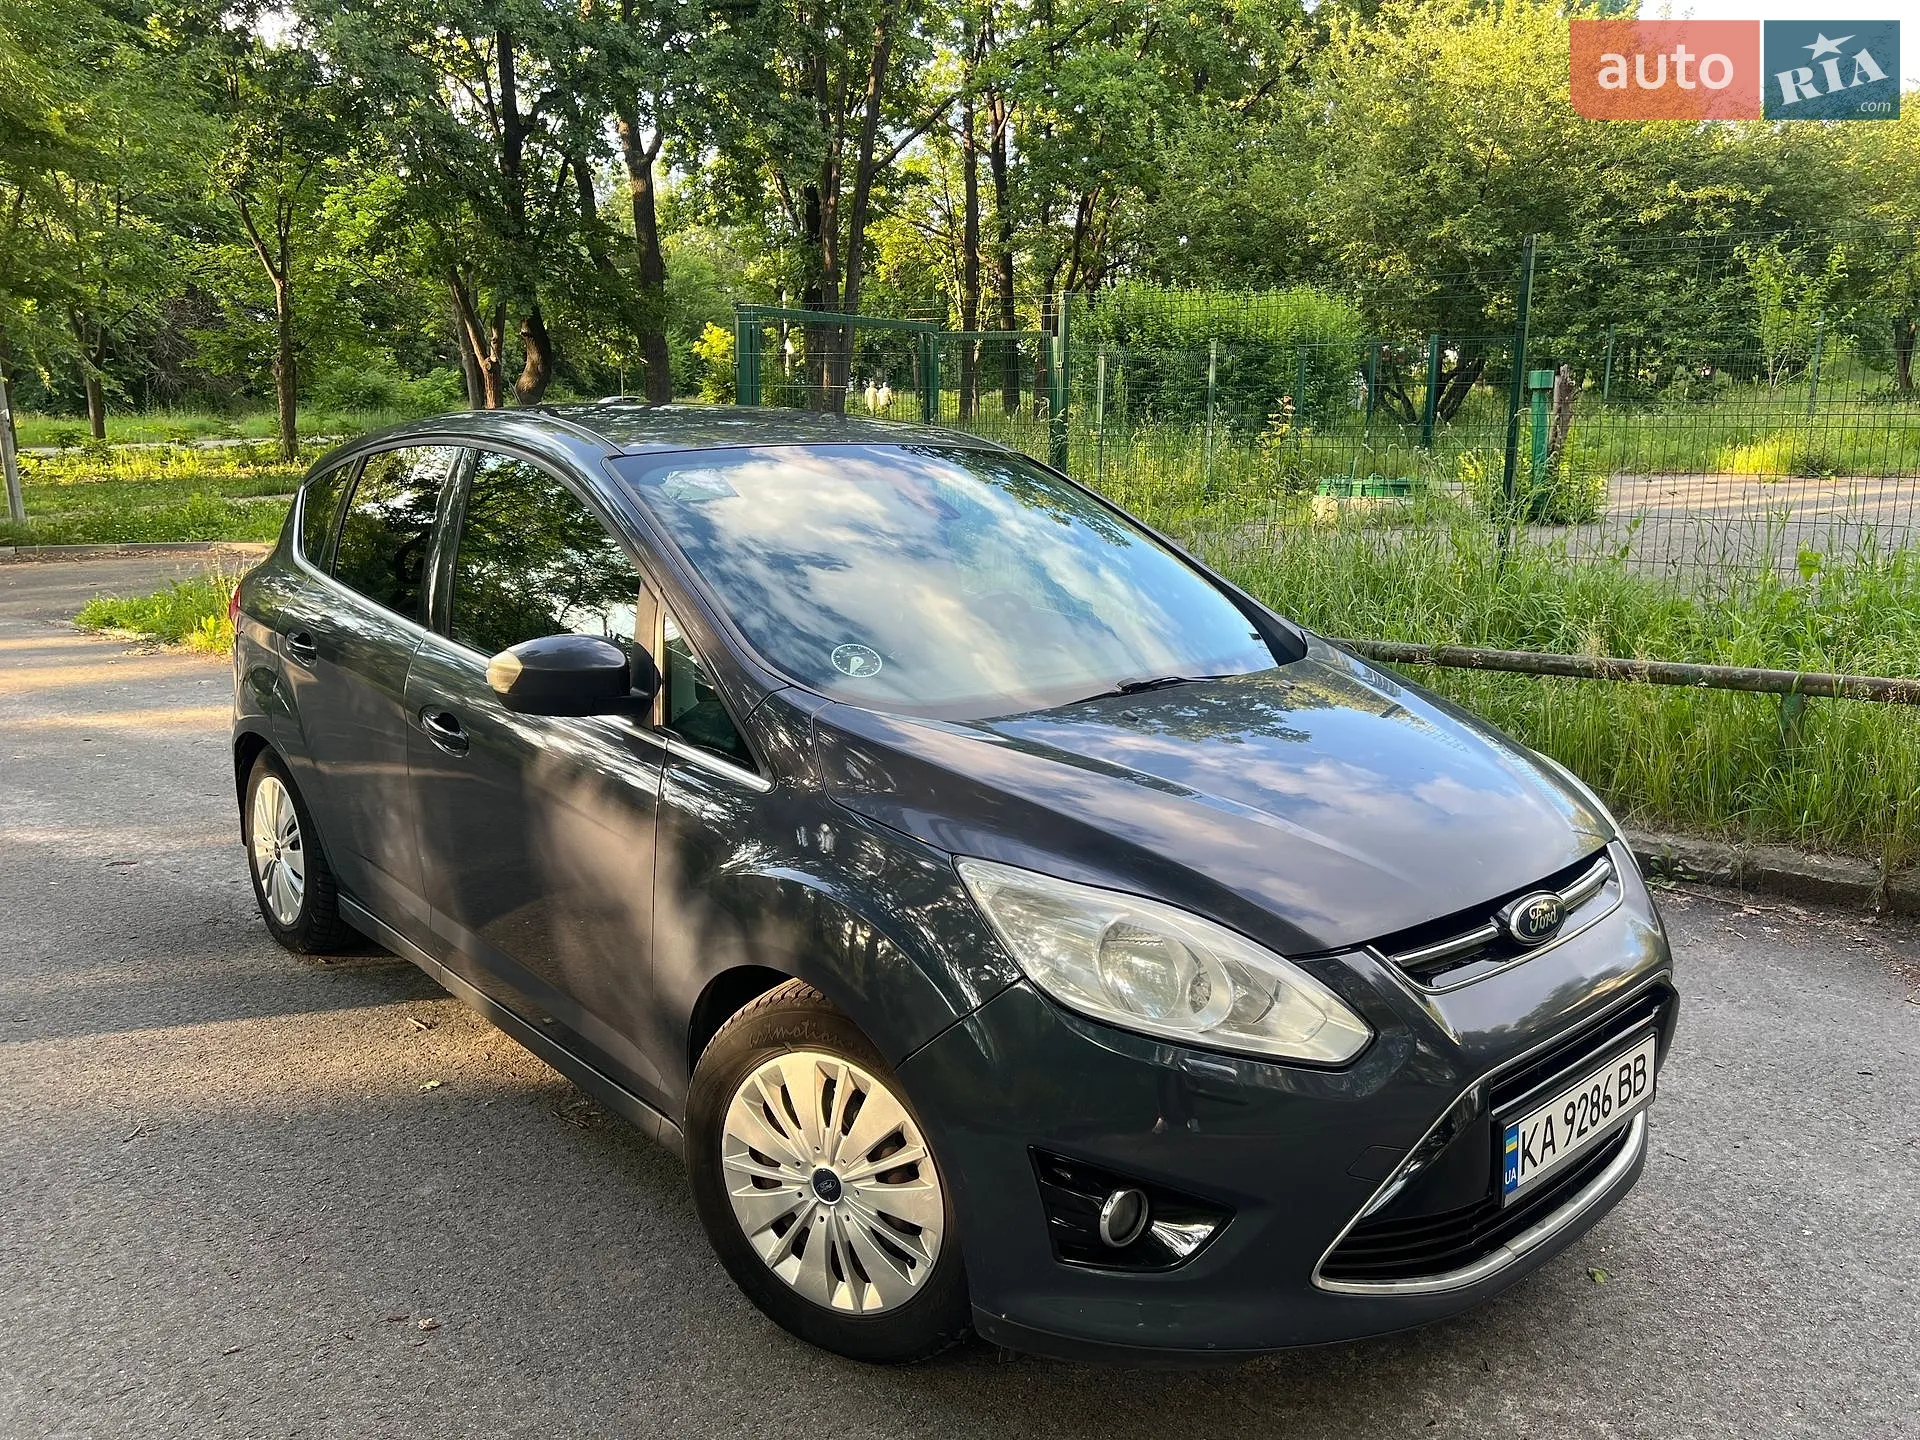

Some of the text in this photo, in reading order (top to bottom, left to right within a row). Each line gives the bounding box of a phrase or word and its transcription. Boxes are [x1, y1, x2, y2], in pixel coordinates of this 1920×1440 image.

[1529, 904, 1559, 933] Ford
[1521, 1053, 1647, 1177] KA 9286 BB
[1505, 1172, 1517, 1185] UA
